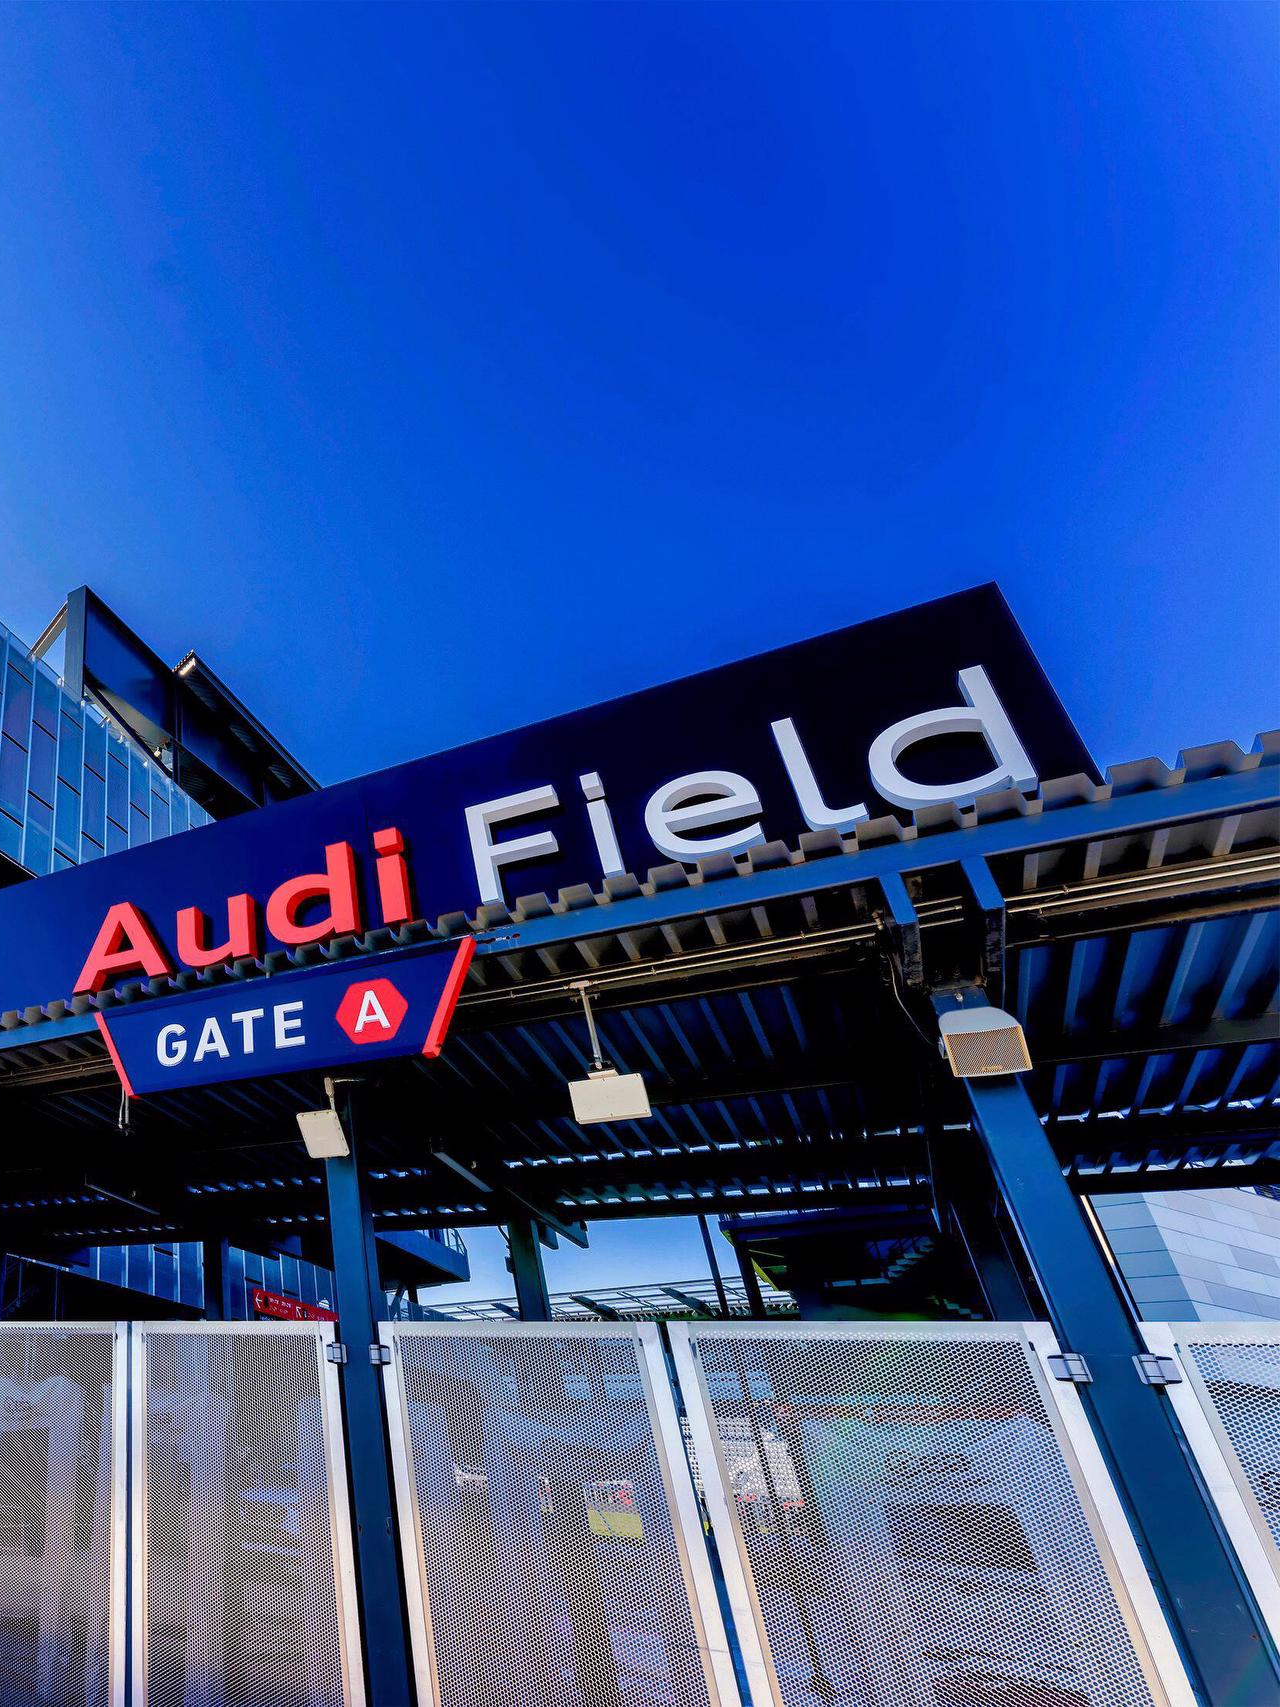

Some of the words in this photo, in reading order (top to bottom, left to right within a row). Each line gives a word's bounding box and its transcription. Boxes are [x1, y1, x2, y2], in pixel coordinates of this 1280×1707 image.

[72, 827, 412, 994] Audi
[465, 664, 1038, 904] Field
[156, 1001, 306, 1067] GATE
[354, 990, 391, 1033] A
